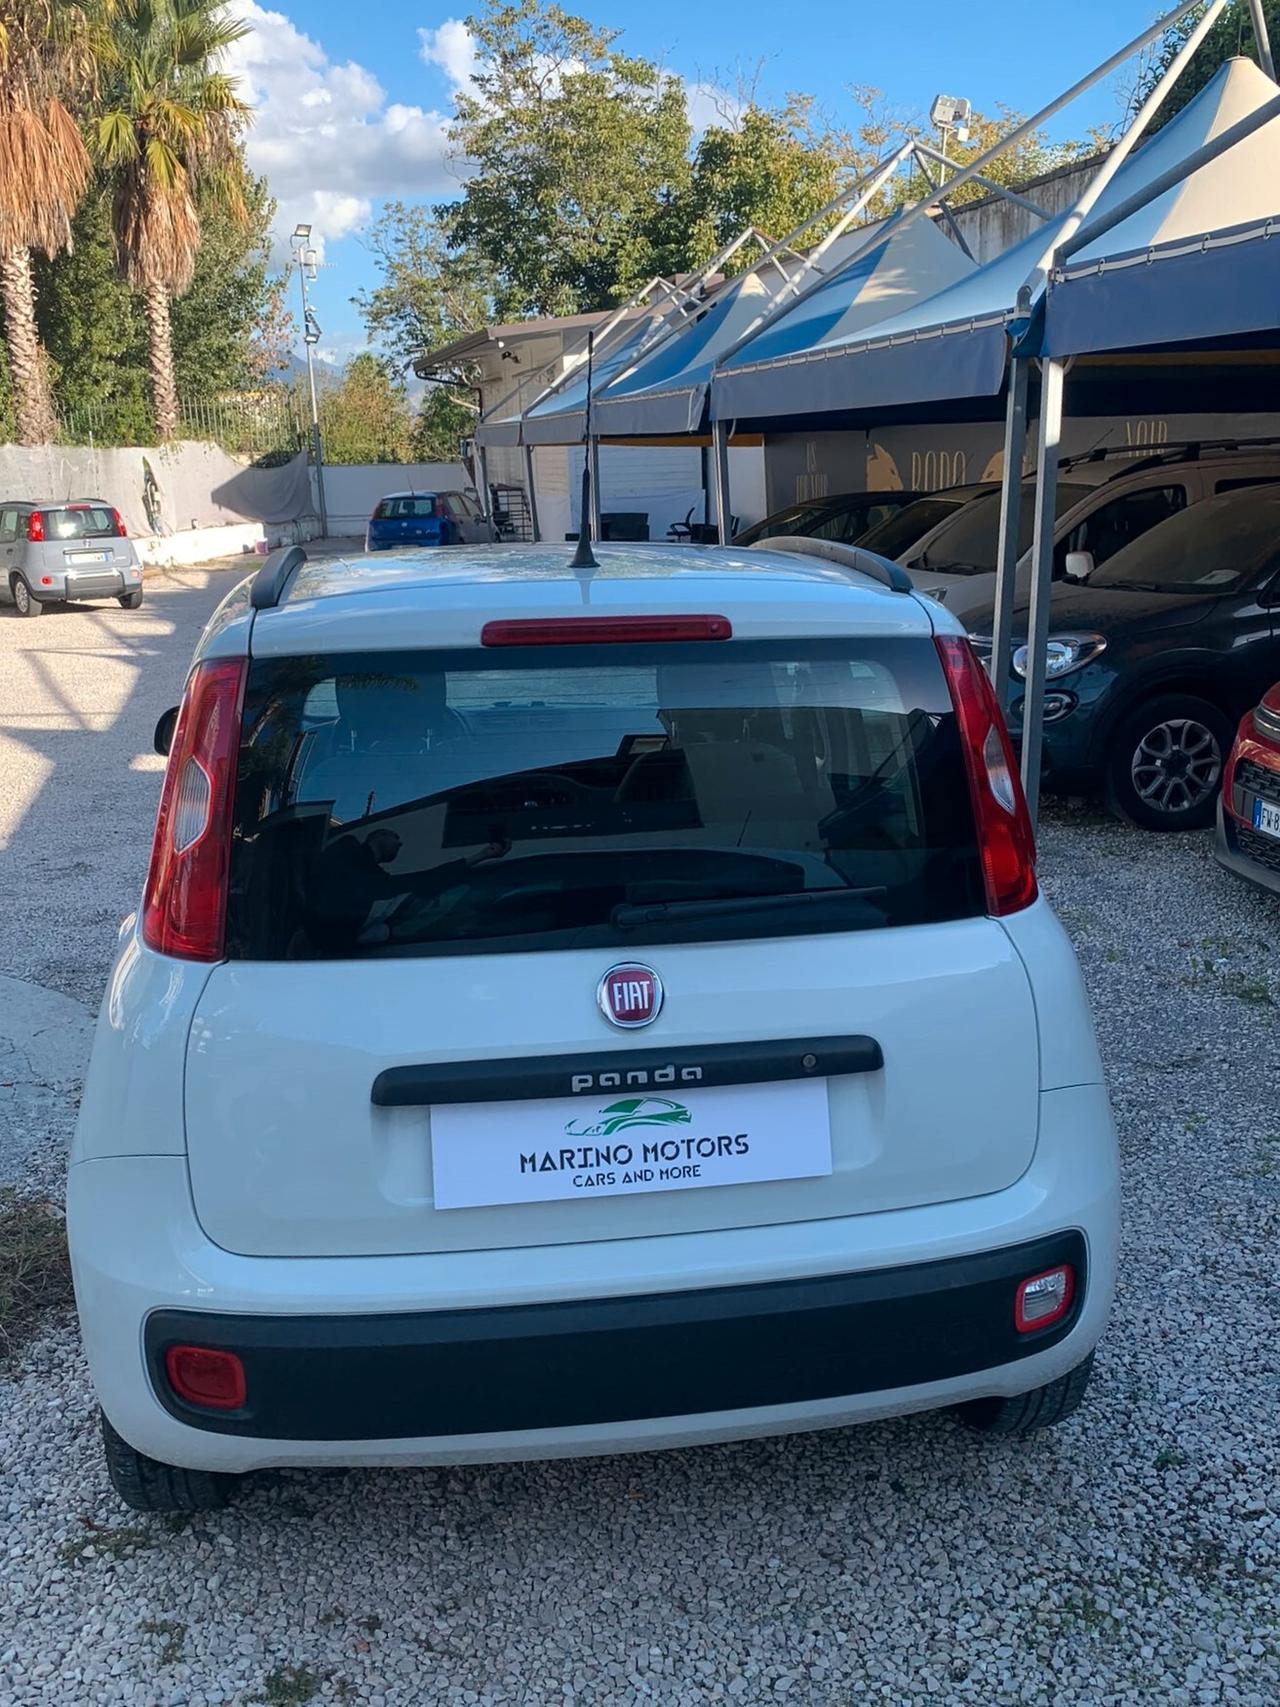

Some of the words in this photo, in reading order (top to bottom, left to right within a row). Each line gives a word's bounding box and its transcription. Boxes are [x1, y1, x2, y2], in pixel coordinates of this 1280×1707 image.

[612, 980, 650, 1012] FIAT
[571, 1064, 703, 1093] panda
[519, 1144, 633, 1174] MARINO
[642, 1133, 750, 1163] MOTORS
[572, 1172, 616, 1188] CARS
[622, 1169, 655, 1184] AND
[659, 1164, 702, 1181] MORE
